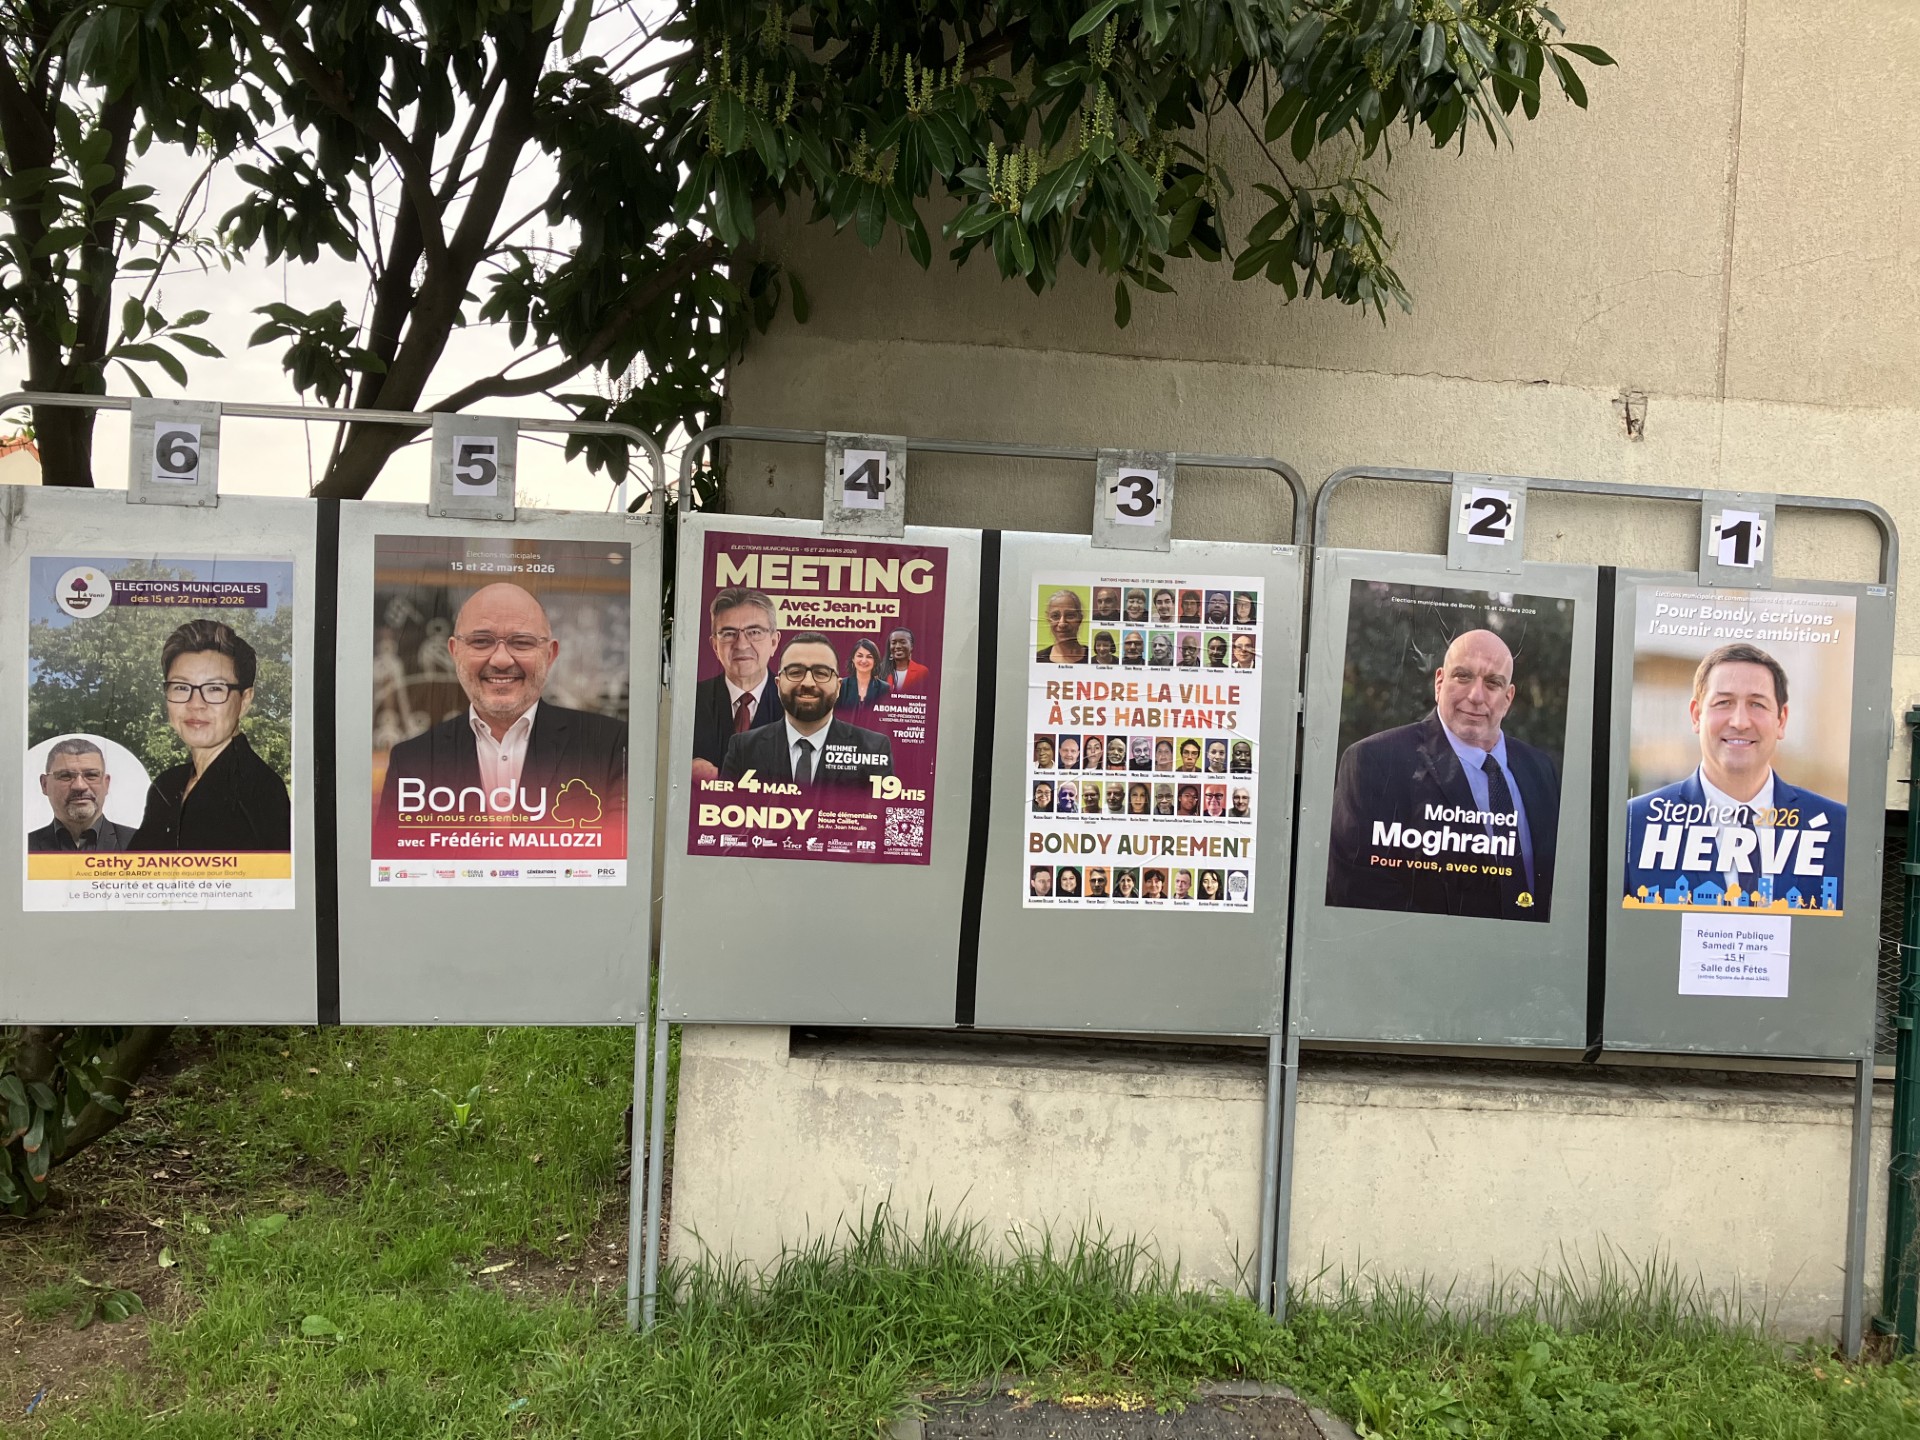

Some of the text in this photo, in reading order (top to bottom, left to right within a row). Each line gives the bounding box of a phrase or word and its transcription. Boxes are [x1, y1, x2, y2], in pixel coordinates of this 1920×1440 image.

[156, 431, 198, 473] 6
[456, 444, 496, 486] 5
[845, 459, 886, 499] 4
[1117, 475, 1155, 517] 3
[1468, 497, 1508, 538] 2
[1721, 521, 1752, 564] 1
[500, 552, 541, 560] municipales
[451, 562, 555, 573] 15 et 22 mars 2026
[716, 552, 935, 594] MEETING
[115, 582, 261, 594] ELECTIONS MUNICIPALES
[130, 595, 148, 603] des
[151, 595, 161, 603] 15
[220, 596, 245, 604] 2026
[779, 599, 896, 614] Avec Jean-Luc
[1391, 596, 1416, 604] Élections
[1417, 600, 1449, 608] municipales
[786, 614, 876, 629] Mélenchon
[1656, 603, 1834, 626] Pour Bondy, écrivons
[1649, 620, 1711, 637] l'avenir
[1714, 626, 1754, 639] avec
[1046, 680, 1240, 705] RENDRE LA VILLE
[873, 704, 926, 714] ABOMANGOLI
[1048, 701, 1237, 730] À SES HABITANTS
[893, 730, 925, 739] TROUVÉ
[825, 752, 888, 766] OZGUNER
[701, 780, 734, 792] MER
[738, 769, 761, 793] 4
[763, 782, 802, 795] MAR.
[398, 777, 547, 822] Bondy
[399, 813, 529, 823] Ce qui nous rassemble
[698, 804, 813, 830] BONDY
[837, 811, 878, 820] élémentaire
[1424, 803, 1518, 827] Mohamed
[1646, 797, 1799, 829] Stephen 2026
[397, 831, 602, 847] avec Frédéric MALLOZZI
[857, 840, 876, 850] PEPS
[1029, 832, 1251, 858] BONDY AUTREMENT
[1371, 820, 1516, 857] Moghrani
[1638, 812, 1831, 876] HERVÉ
[85, 856, 237, 870] Cathy JANKOWSKI
[1370, 855, 1513, 876] Pour vous, avec vous
[92, 881, 139, 889] Sécurité
[157, 881, 195, 890] qualité
[198, 881, 212, 889] de
[216, 880, 232, 889] vie
[83, 892, 112, 900] Bondy
[1697, 929, 1774, 941] Réunion Publique
[1702, 941, 1735, 950] Samedi
[1739, 954, 1745, 962] H
[1701, 964, 1722, 972] Salle
